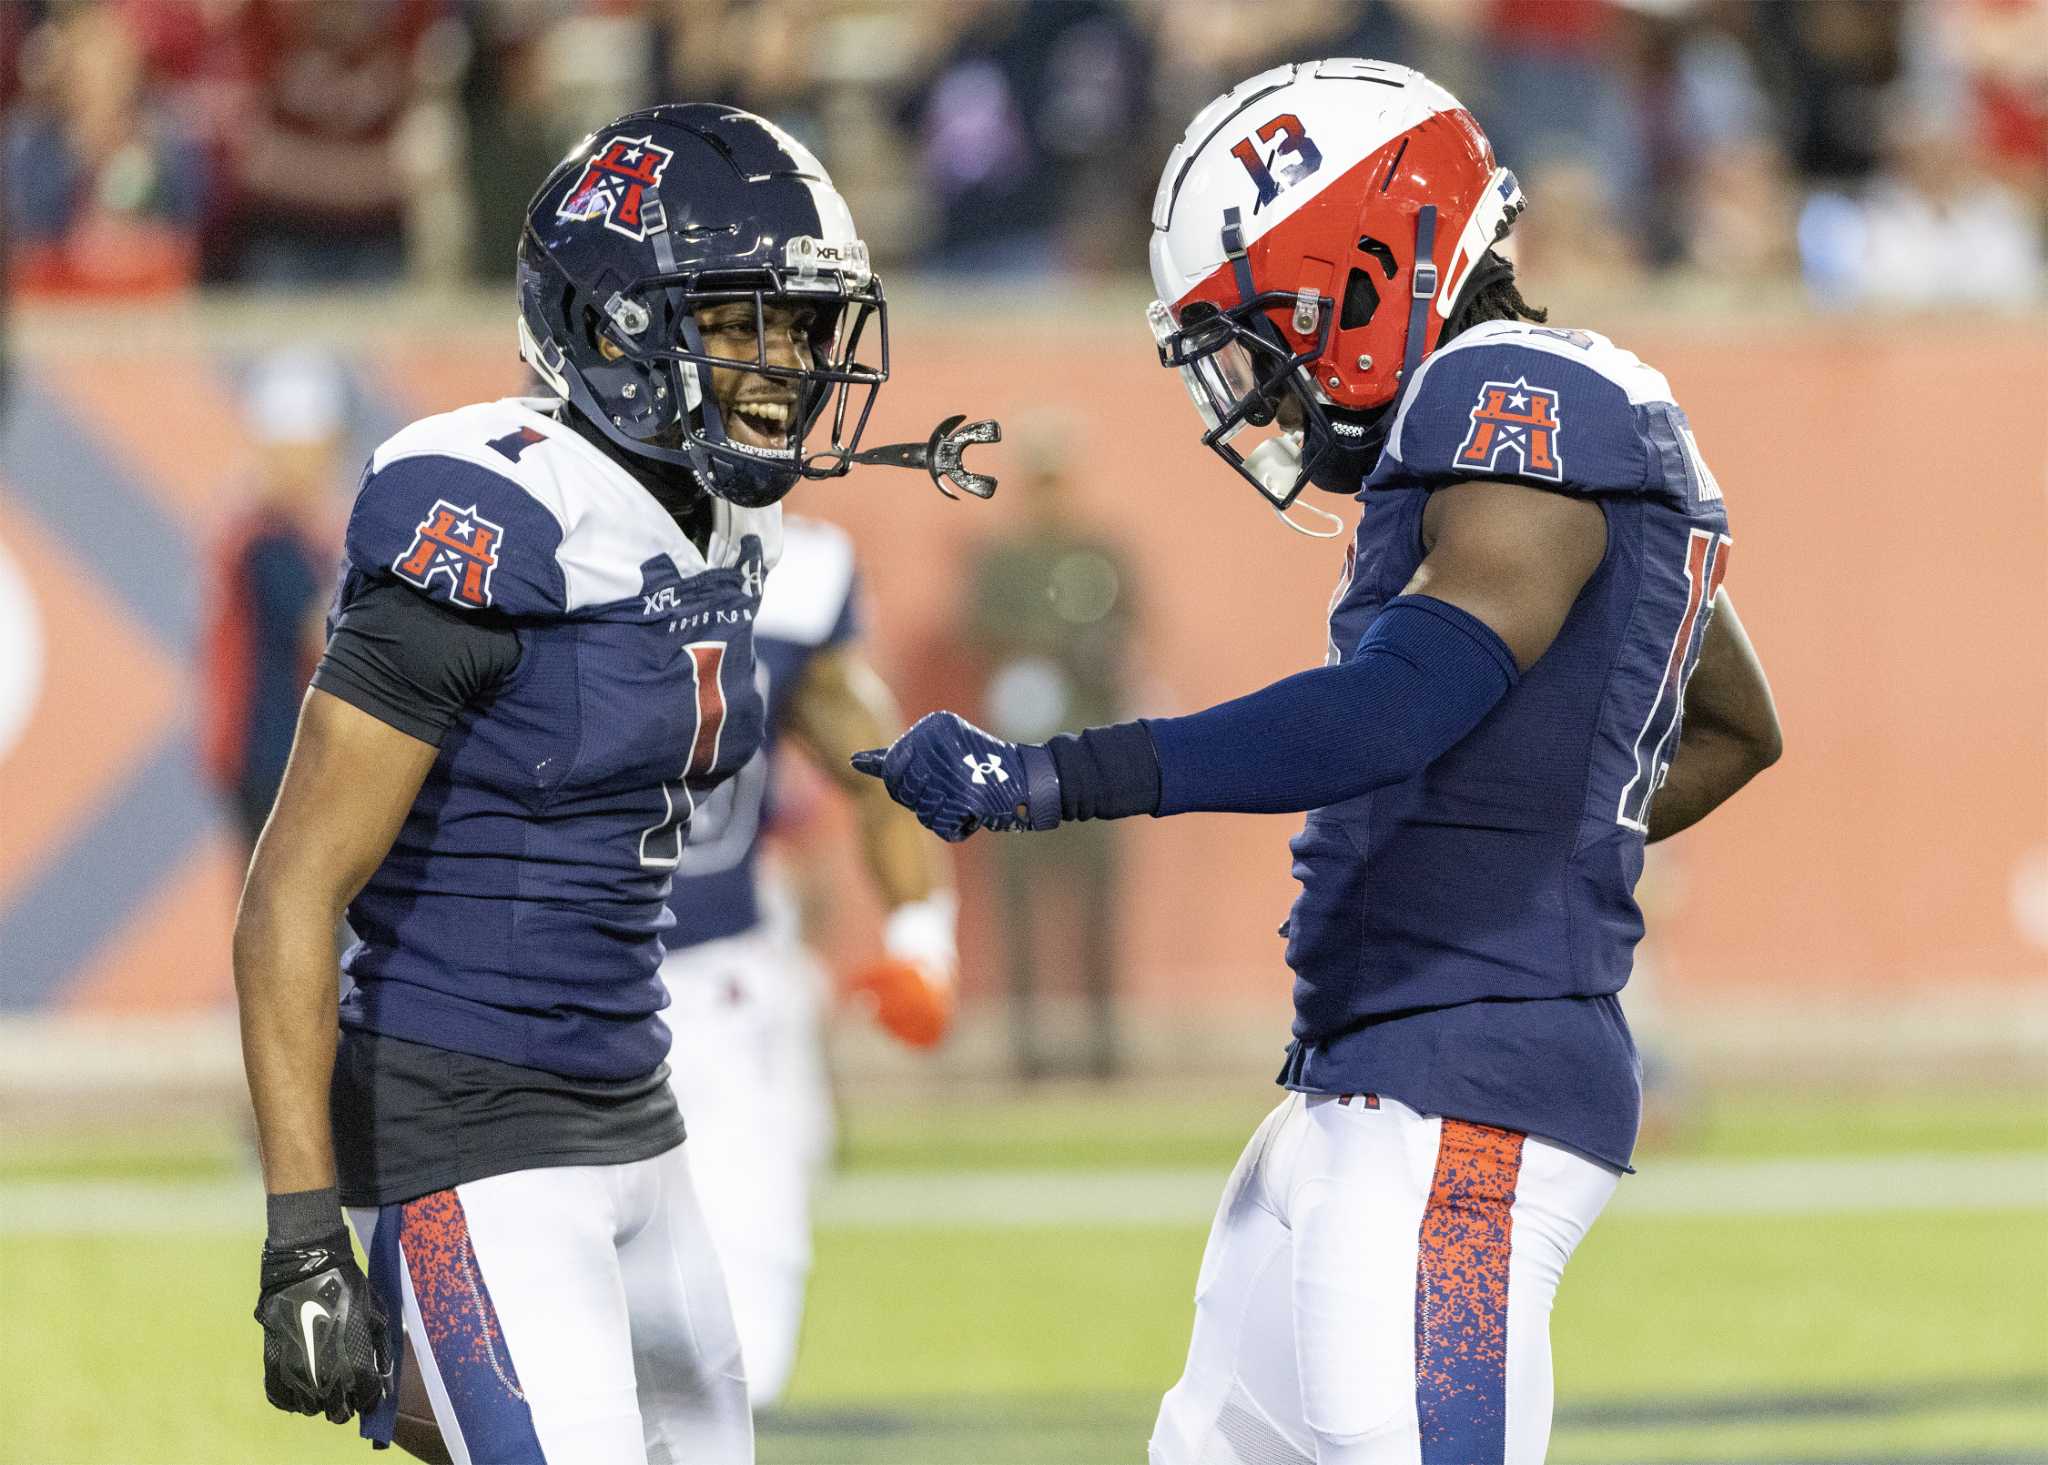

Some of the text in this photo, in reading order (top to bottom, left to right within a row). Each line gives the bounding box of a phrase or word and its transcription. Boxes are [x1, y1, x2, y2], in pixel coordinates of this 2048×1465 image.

[1230, 113, 1323, 207] 13
[816, 247, 845, 261] XFL
[643, 586, 681, 615] XFL
[669, 608, 753, 633] HOUSTON
[640, 641, 728, 867] 1
